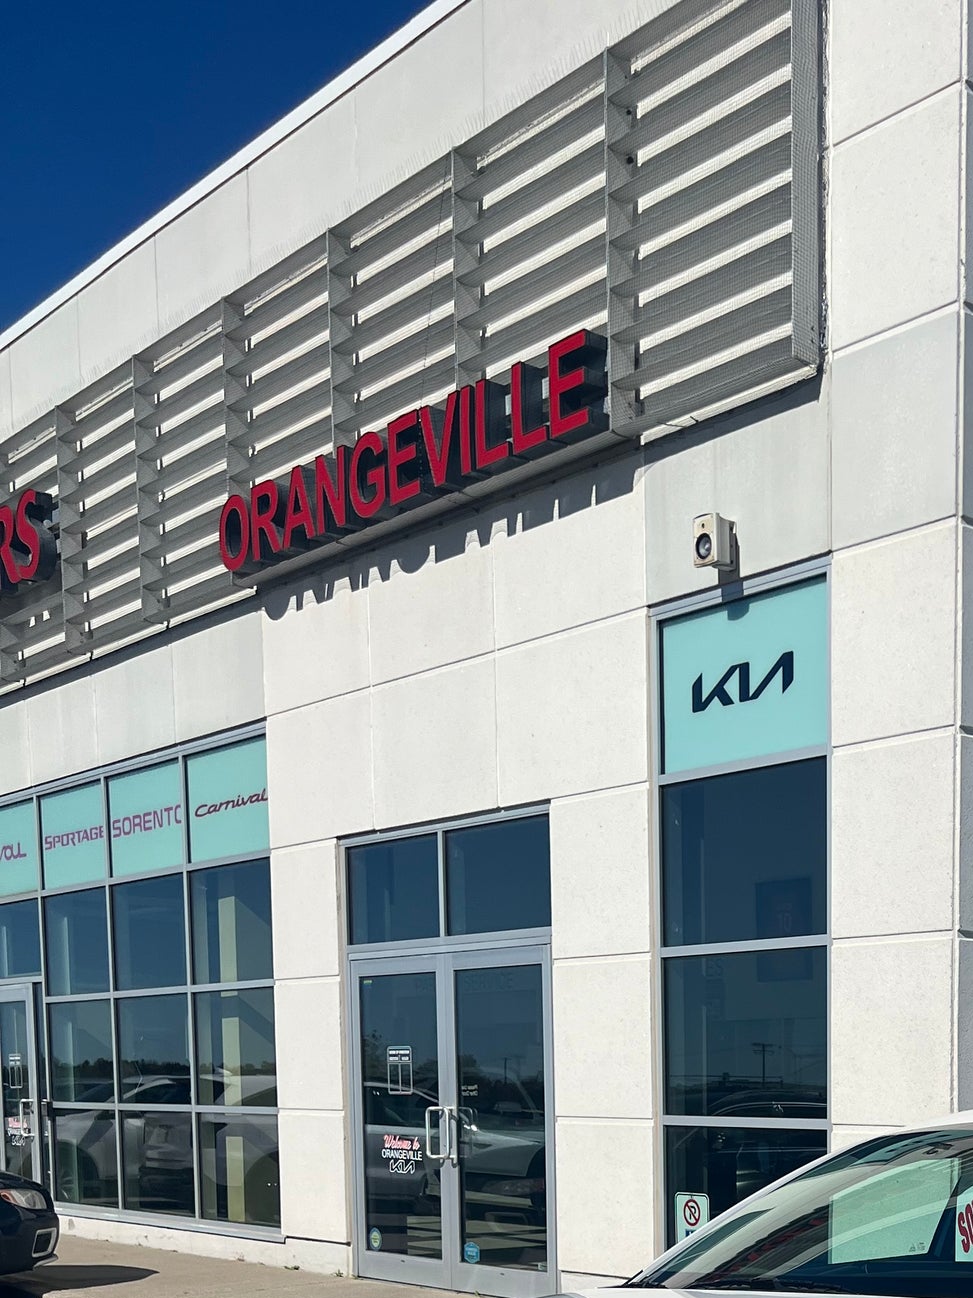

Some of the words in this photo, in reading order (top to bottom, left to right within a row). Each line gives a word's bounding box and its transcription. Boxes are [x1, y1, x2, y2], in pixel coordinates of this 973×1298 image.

[219, 329, 590, 572] ORANGEVILLE
[692, 650, 794, 714] KIA
[194, 788, 268, 818] Carnival
[44, 825, 104, 851] SPORTAGE
[381, 1149, 423, 1161] ORANGEVILLE
[389, 1159, 416, 1174] KIA
